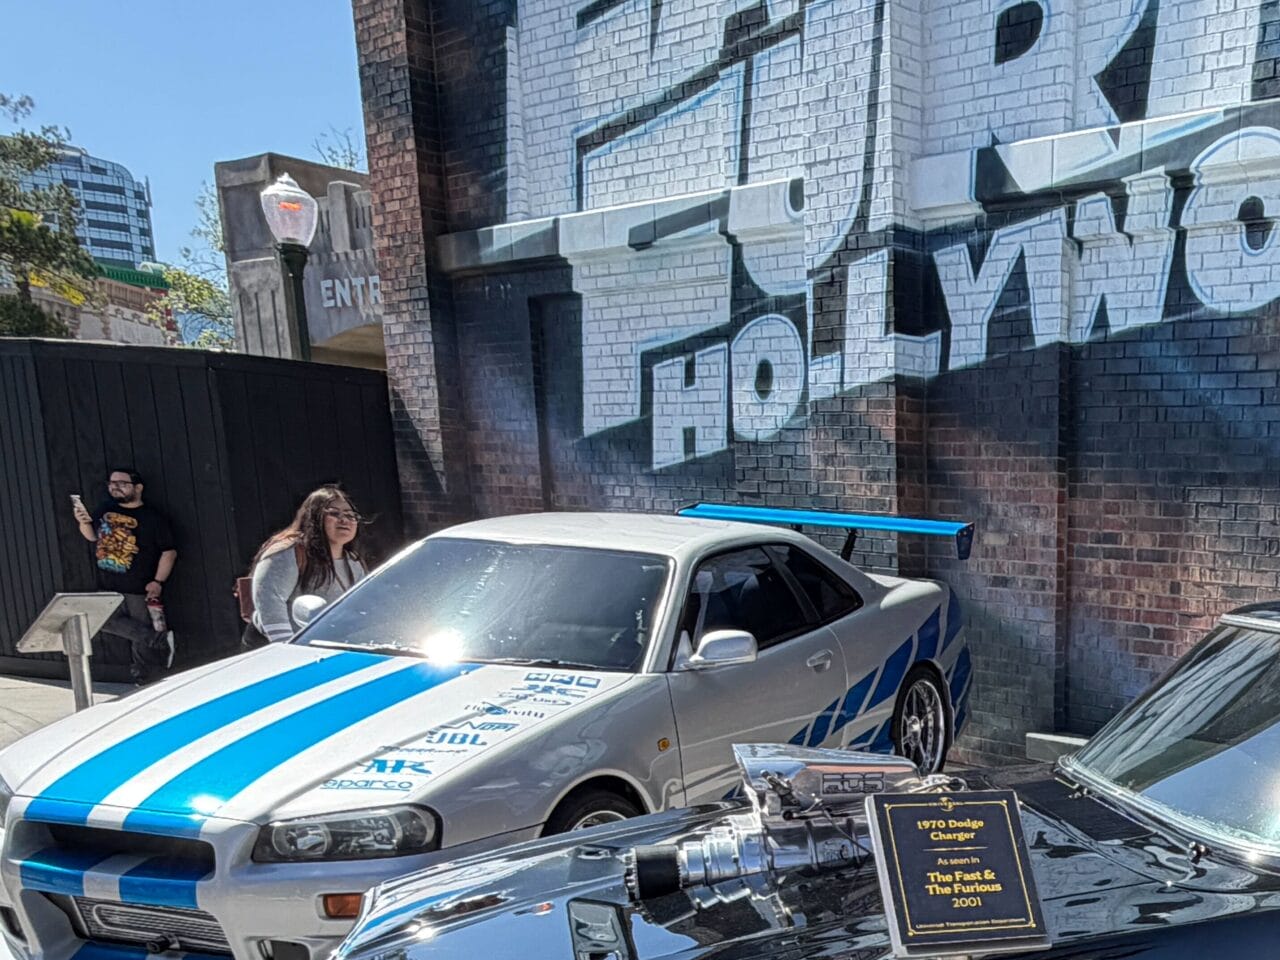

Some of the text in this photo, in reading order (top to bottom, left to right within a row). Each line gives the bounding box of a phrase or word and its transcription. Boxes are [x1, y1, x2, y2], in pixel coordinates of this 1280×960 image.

[320, 274, 380, 308] ENTR
[425, 732, 488, 746] JBL
[917, 819, 984, 830] 1970 Dodge
[930, 831, 976, 841] Charger
[937, 856, 980, 865] As seen in
[927, 869, 996, 882] The Fast &
[926, 883, 1002, 895] The Furious
[952, 896, 982, 908] 2001
